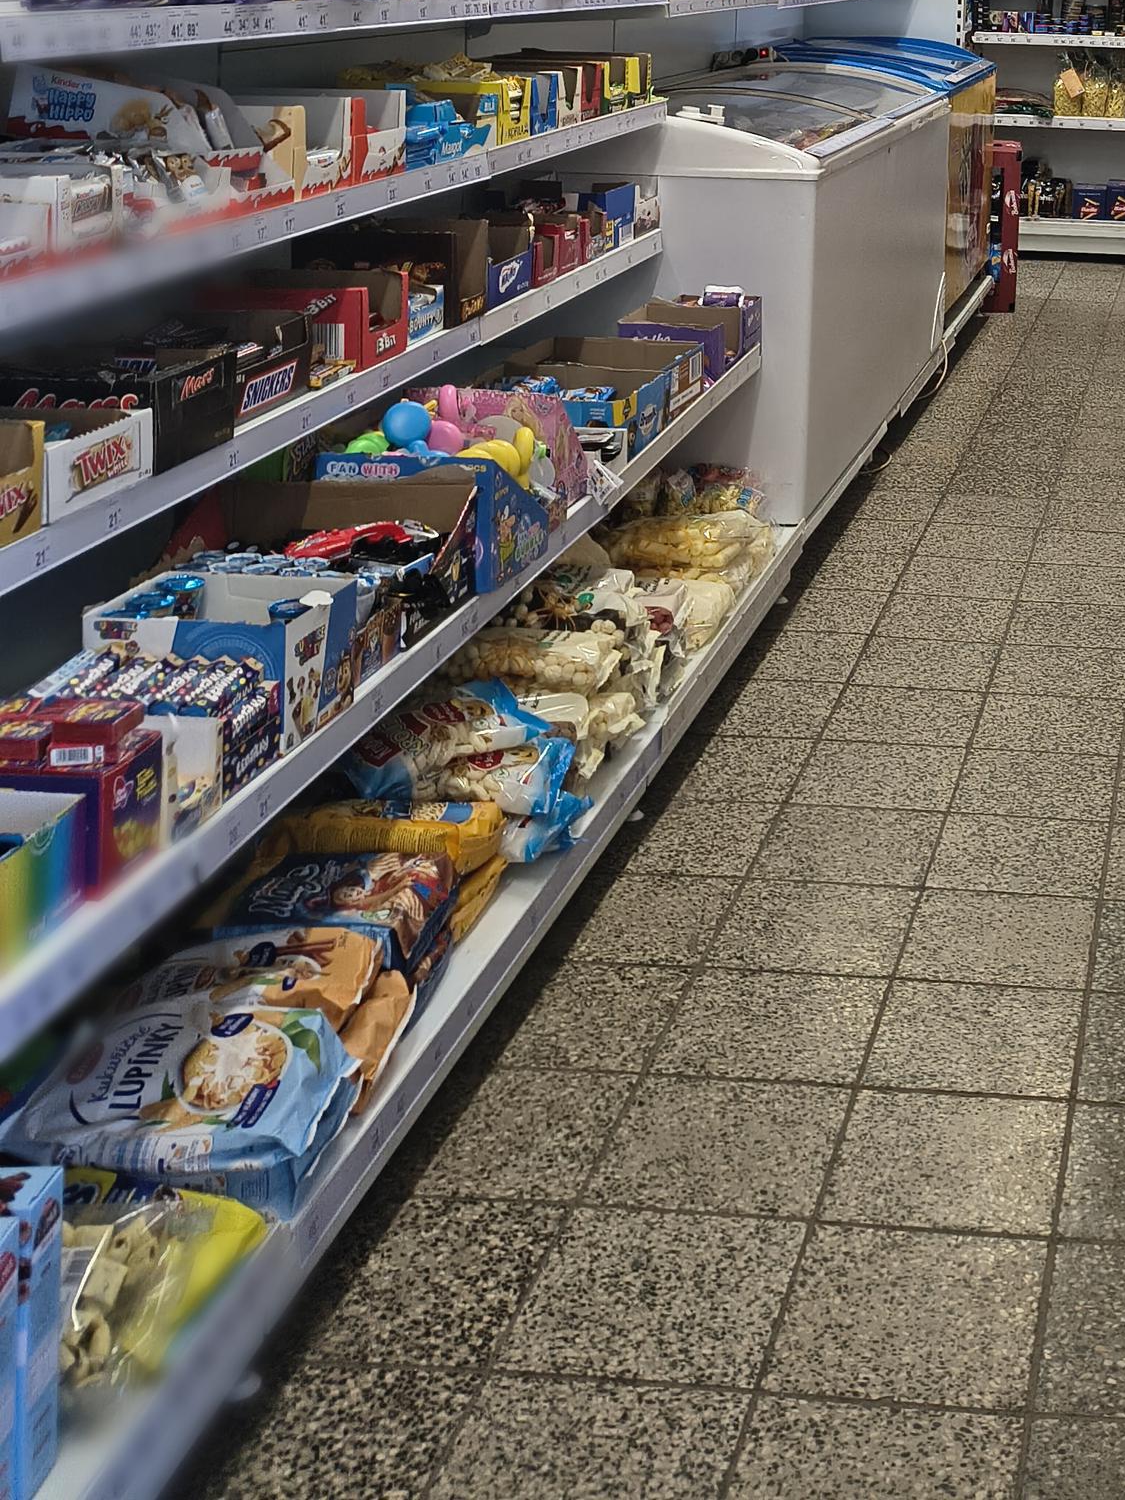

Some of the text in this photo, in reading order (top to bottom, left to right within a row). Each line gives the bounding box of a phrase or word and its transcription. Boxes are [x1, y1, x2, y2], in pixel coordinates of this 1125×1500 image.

[180, 367, 216, 401] Mars
[241, 364, 296, 412] SNICKERS
[329, 462, 398, 477] FAN WITH
[108, 1021, 184, 1111] LUPÍNKY
